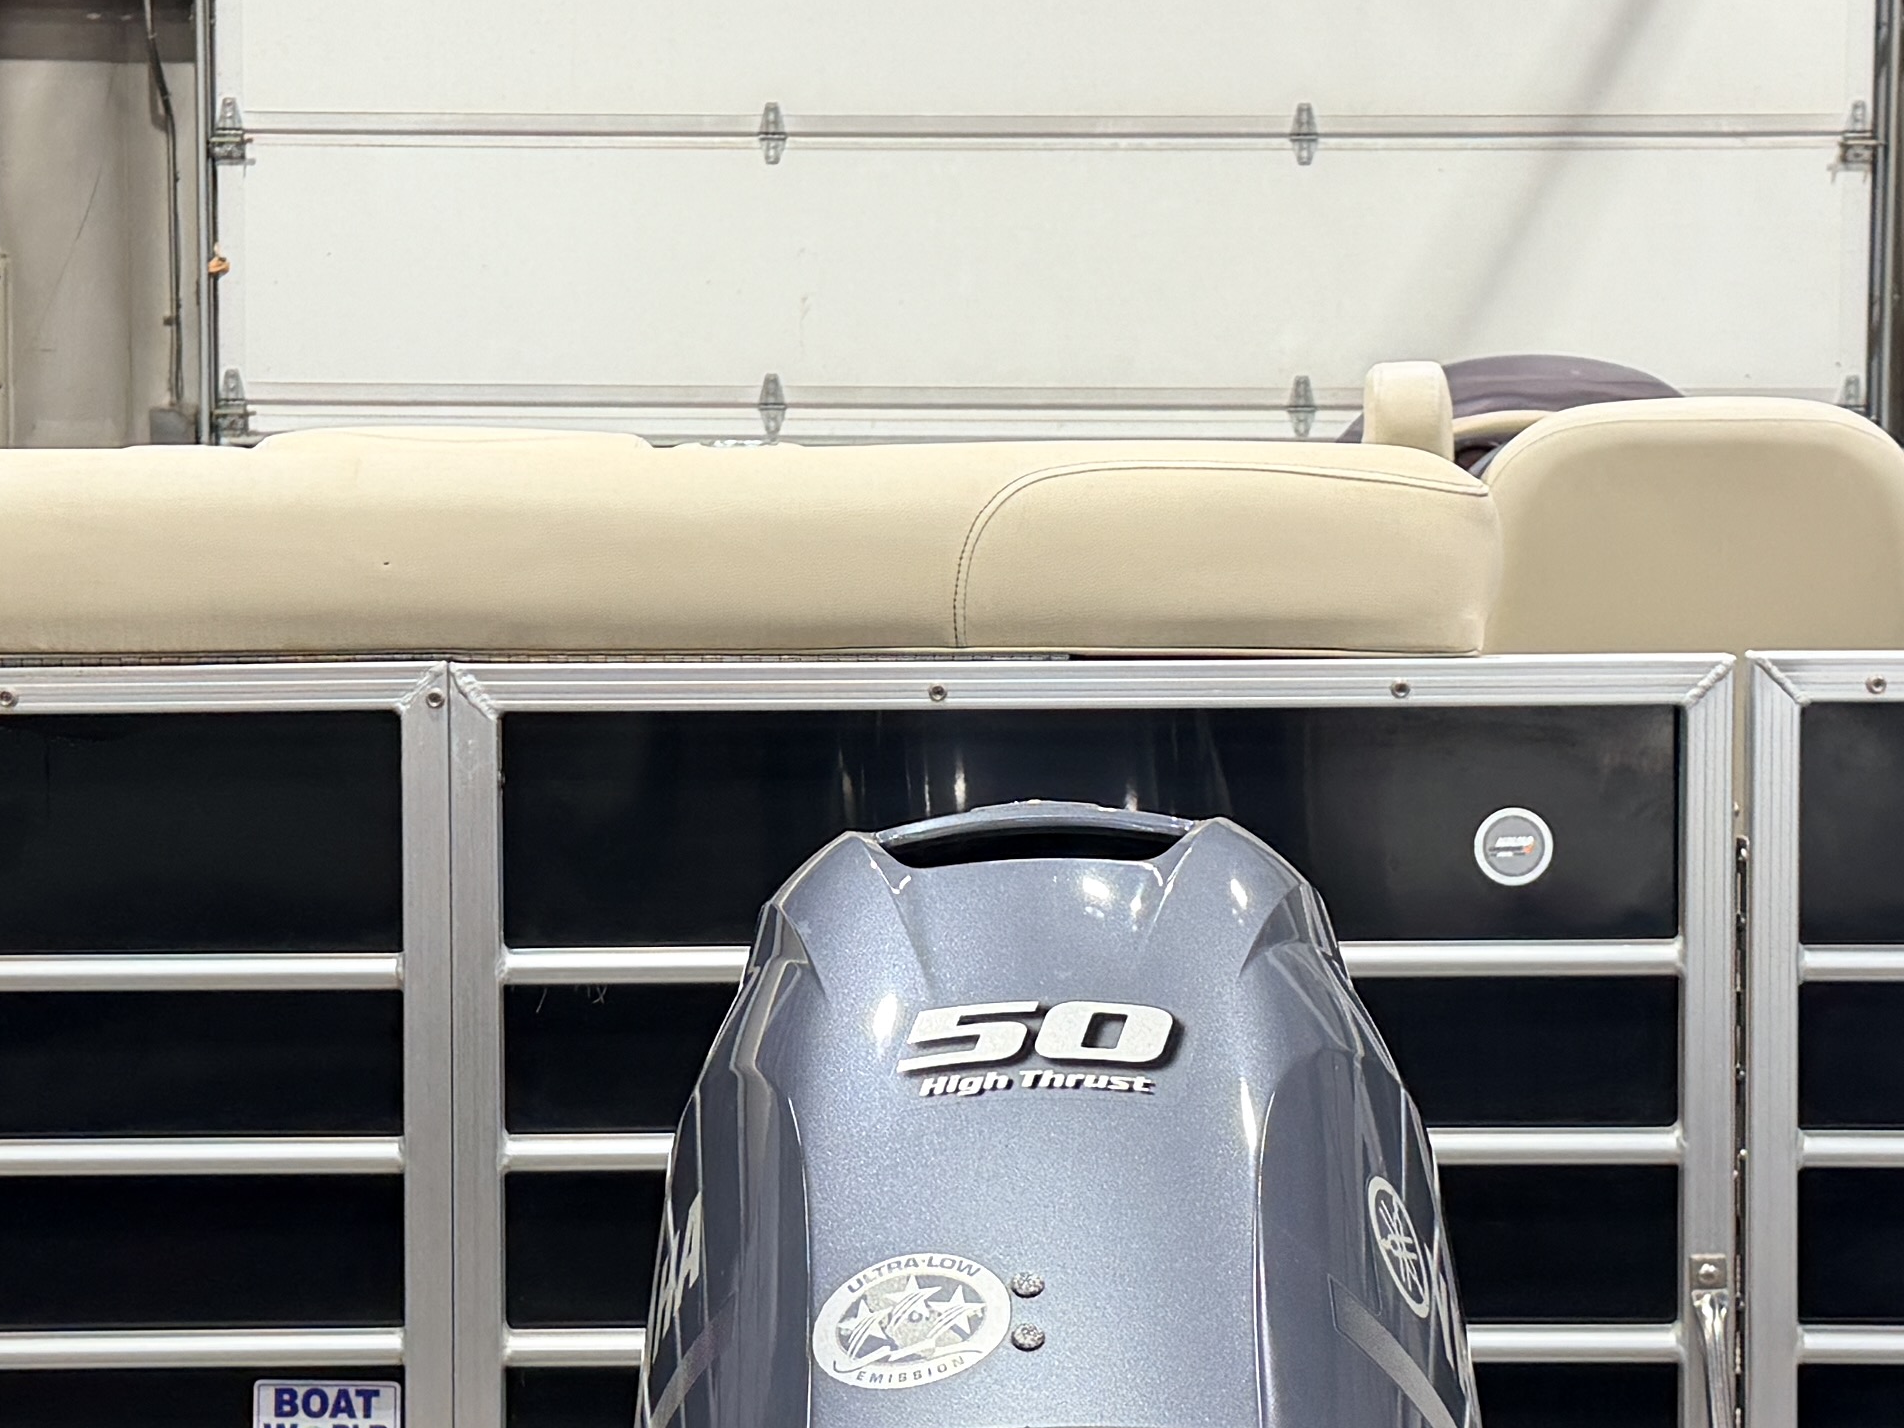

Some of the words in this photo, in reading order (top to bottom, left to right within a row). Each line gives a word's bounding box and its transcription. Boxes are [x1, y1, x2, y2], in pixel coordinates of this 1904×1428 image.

[896, 999, 1176, 1074] 50
[919, 1070, 1010, 1097] High
[1019, 1069, 1155, 1094] Thrust
[856, 1355, 966, 1384] EMISSION
[274, 1387, 381, 1419] BOAT
